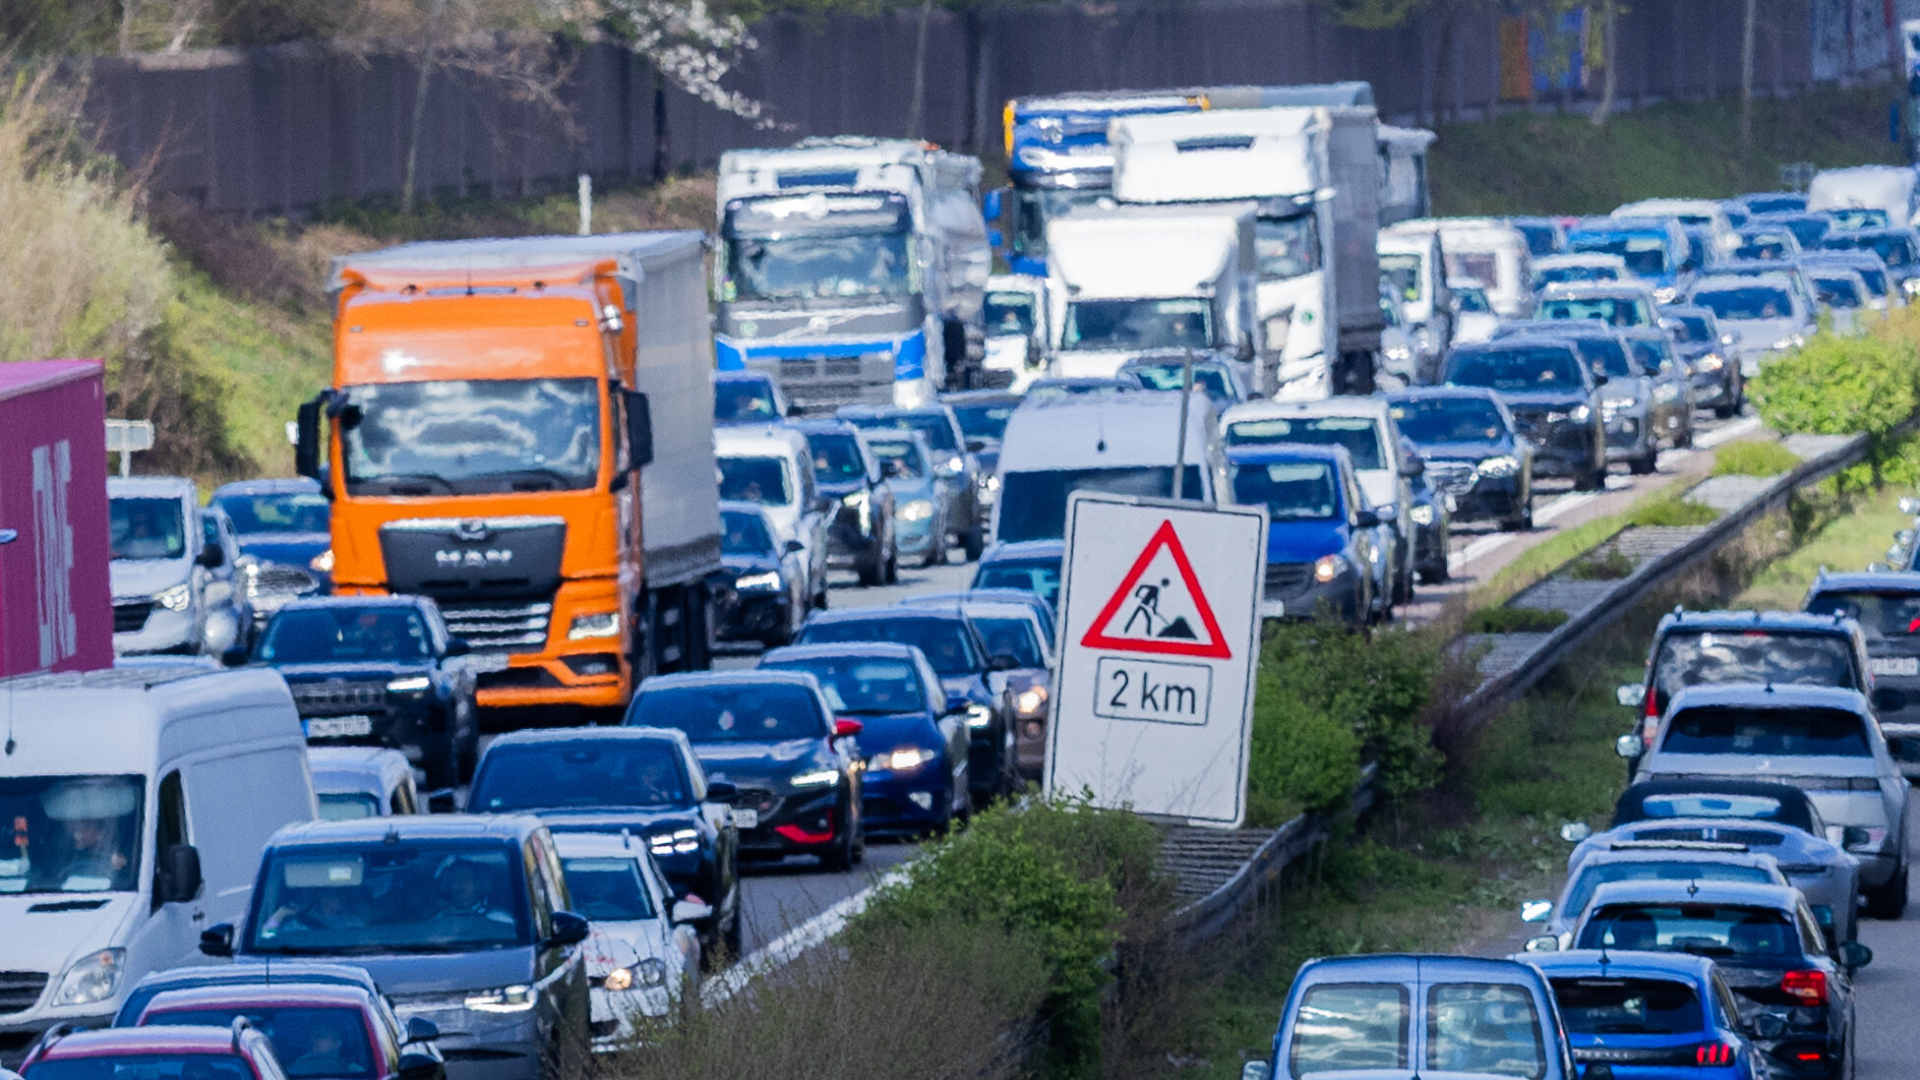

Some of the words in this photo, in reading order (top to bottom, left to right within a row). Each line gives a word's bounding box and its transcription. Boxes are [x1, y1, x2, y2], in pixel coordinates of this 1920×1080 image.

[435, 549, 513, 568] MAN
[1110, 669, 1129, 707] 2
[1141, 671, 1196, 714] km
